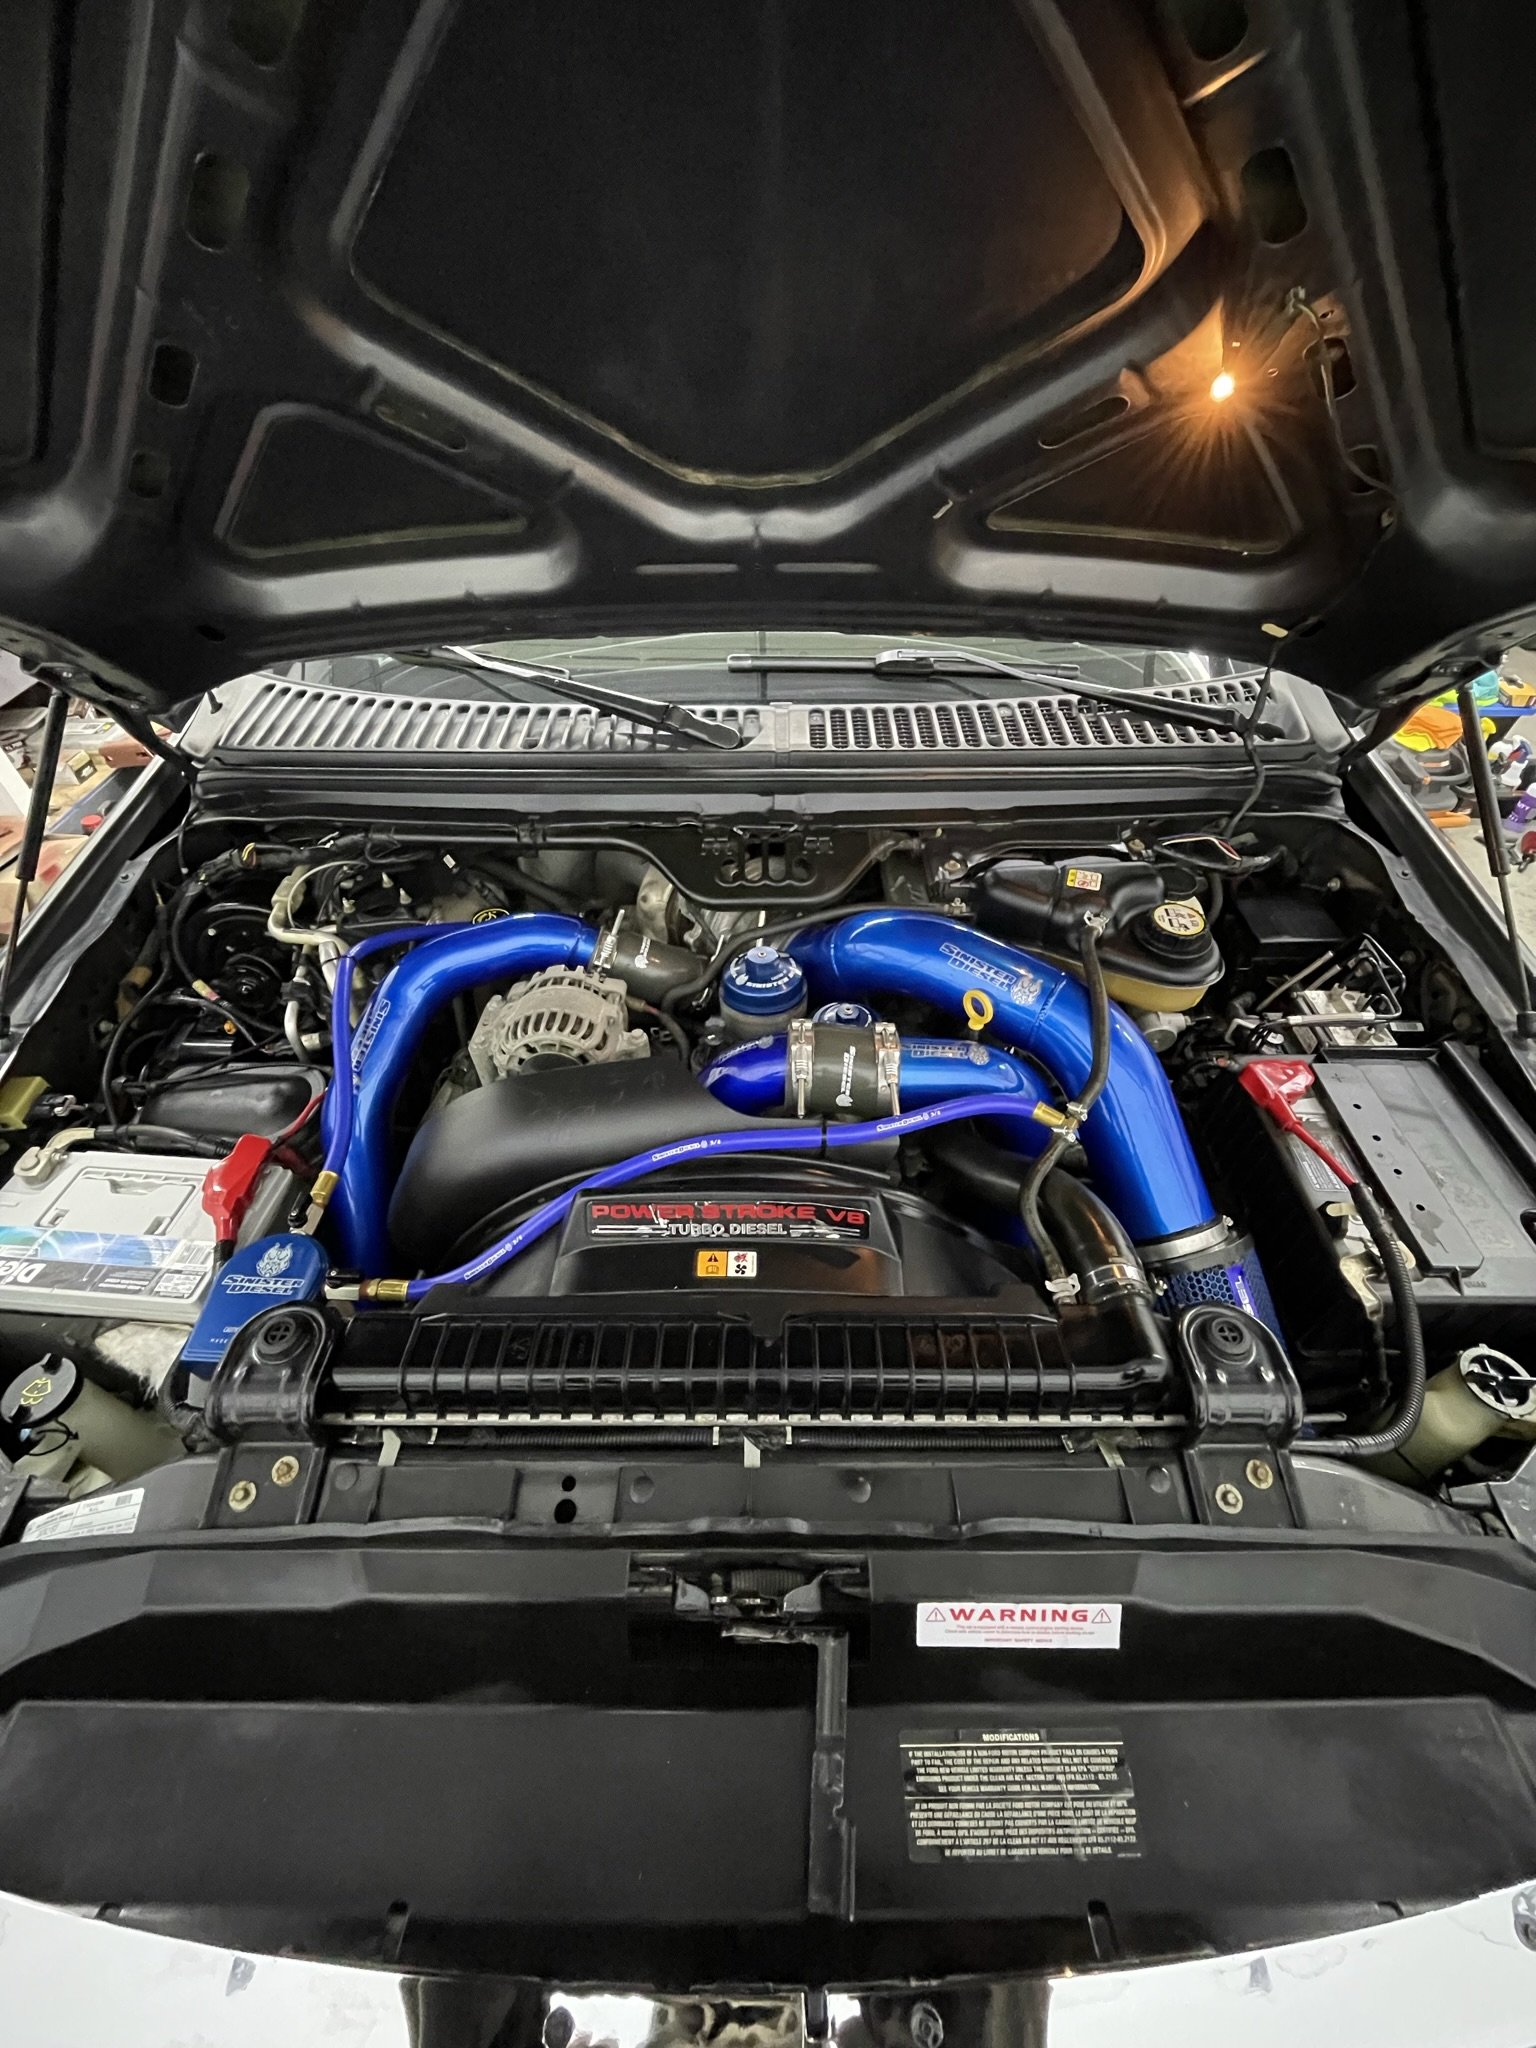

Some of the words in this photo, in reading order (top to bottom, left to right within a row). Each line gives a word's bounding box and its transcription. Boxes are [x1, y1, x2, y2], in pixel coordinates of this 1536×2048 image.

[939, 942, 1016, 985] SINISTER
[948, 956, 1012, 991] DIESEL
[352, 997, 391, 1072] SINISTER
[591, 1204, 695, 1220] POWER
[701, 1204, 817, 1220] STROKE
[827, 1208, 865, 1225] V8
[669, 1222, 724, 1236] TURBO
[730, 1222, 787, 1235] DIESEL
[221, 1274, 305, 1288] SINISTER
[226, 1284, 295, 1296] DIESEL
[949, 1608, 1088, 1623] WARNING
[982, 1733, 1040, 1742] MODIFICATIONS
